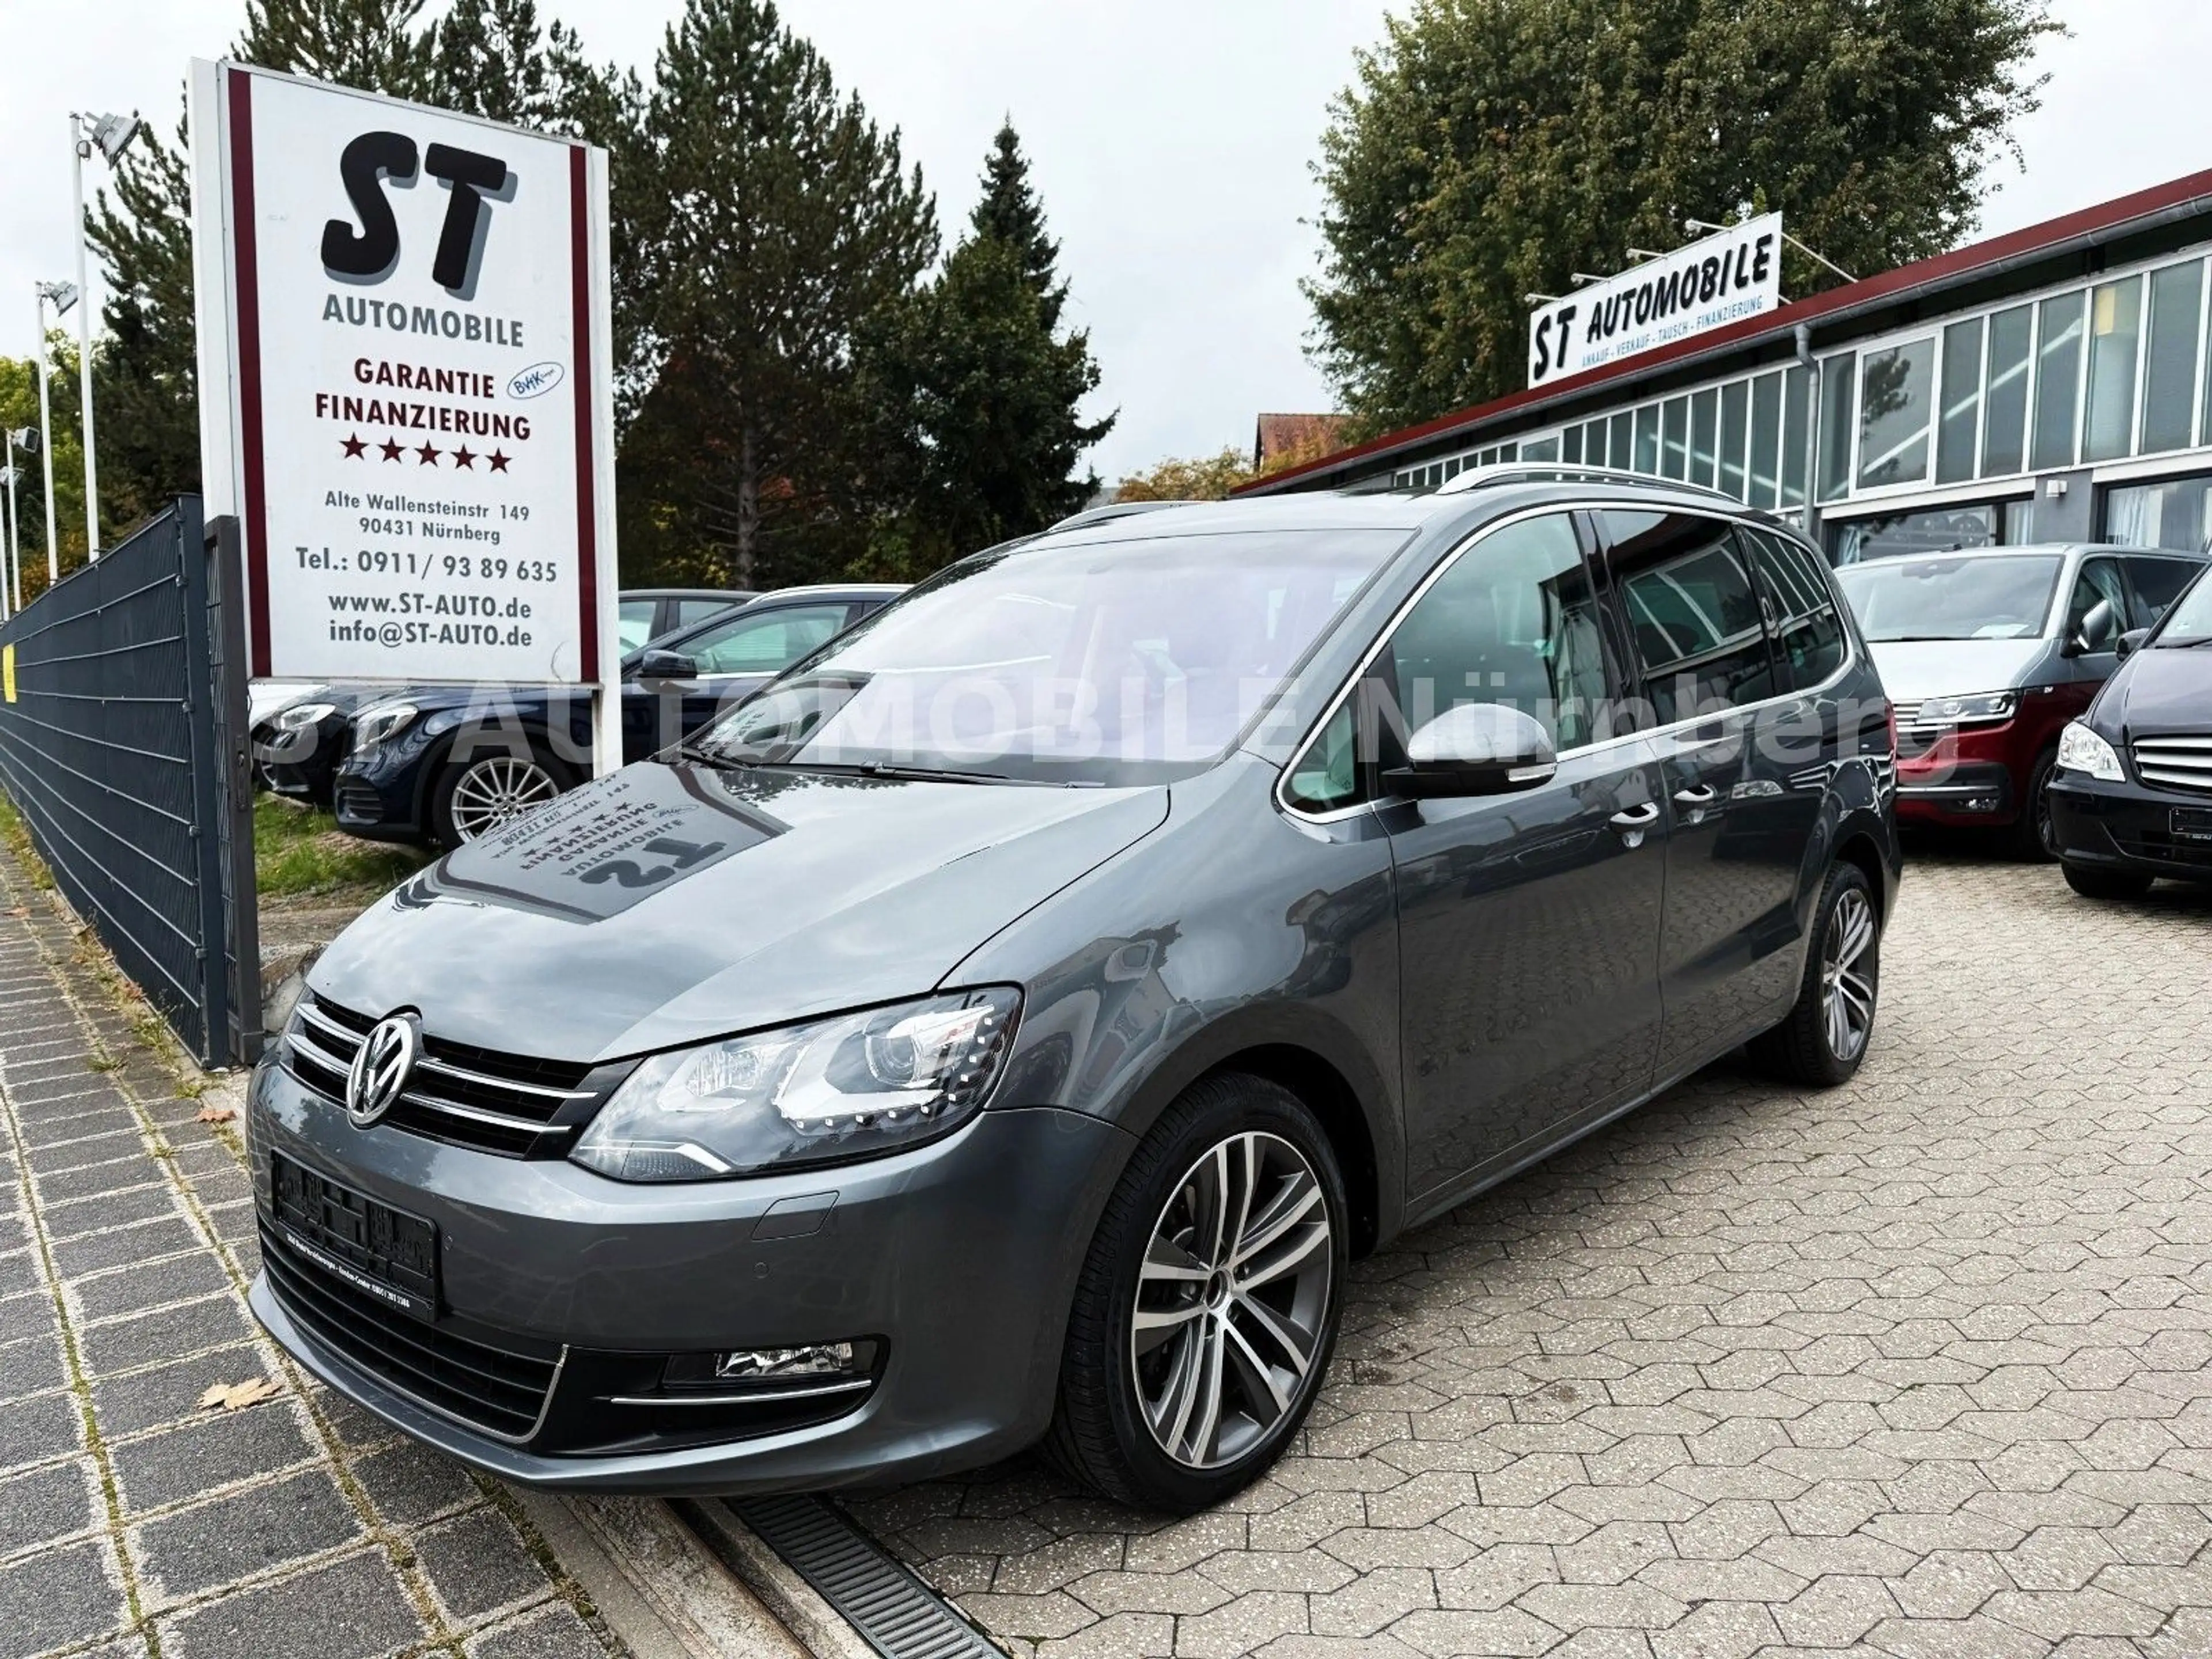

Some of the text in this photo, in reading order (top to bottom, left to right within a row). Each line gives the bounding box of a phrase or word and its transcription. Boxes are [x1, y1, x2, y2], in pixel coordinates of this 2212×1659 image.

[321, 131, 518, 301] ST
[322, 293, 524, 347] AUTOMOBILE
[1533, 233, 1773, 381] ST AUTOMOBILE
[1658, 321, 1688, 341] TAUSCH
[1697, 296, 1763, 331] FINANZIERUNG
[354, 358, 494, 399] GARANTIE
[316, 393, 531, 440] FINANZIERUNG
[325, 491, 529, 521] Alte Wallensteinstr 149
[359, 517, 501, 545] 90431 Nürnberg
[296, 547, 347, 570] Tel.:
[443, 555, 471, 577] 93
[480, 559, 507, 579] 89
[516, 560, 557, 582] 635
[328, 593, 532, 618] www.ST-AUTO.de
[329, 620, 532, 647] info@ST-AUTO.de
